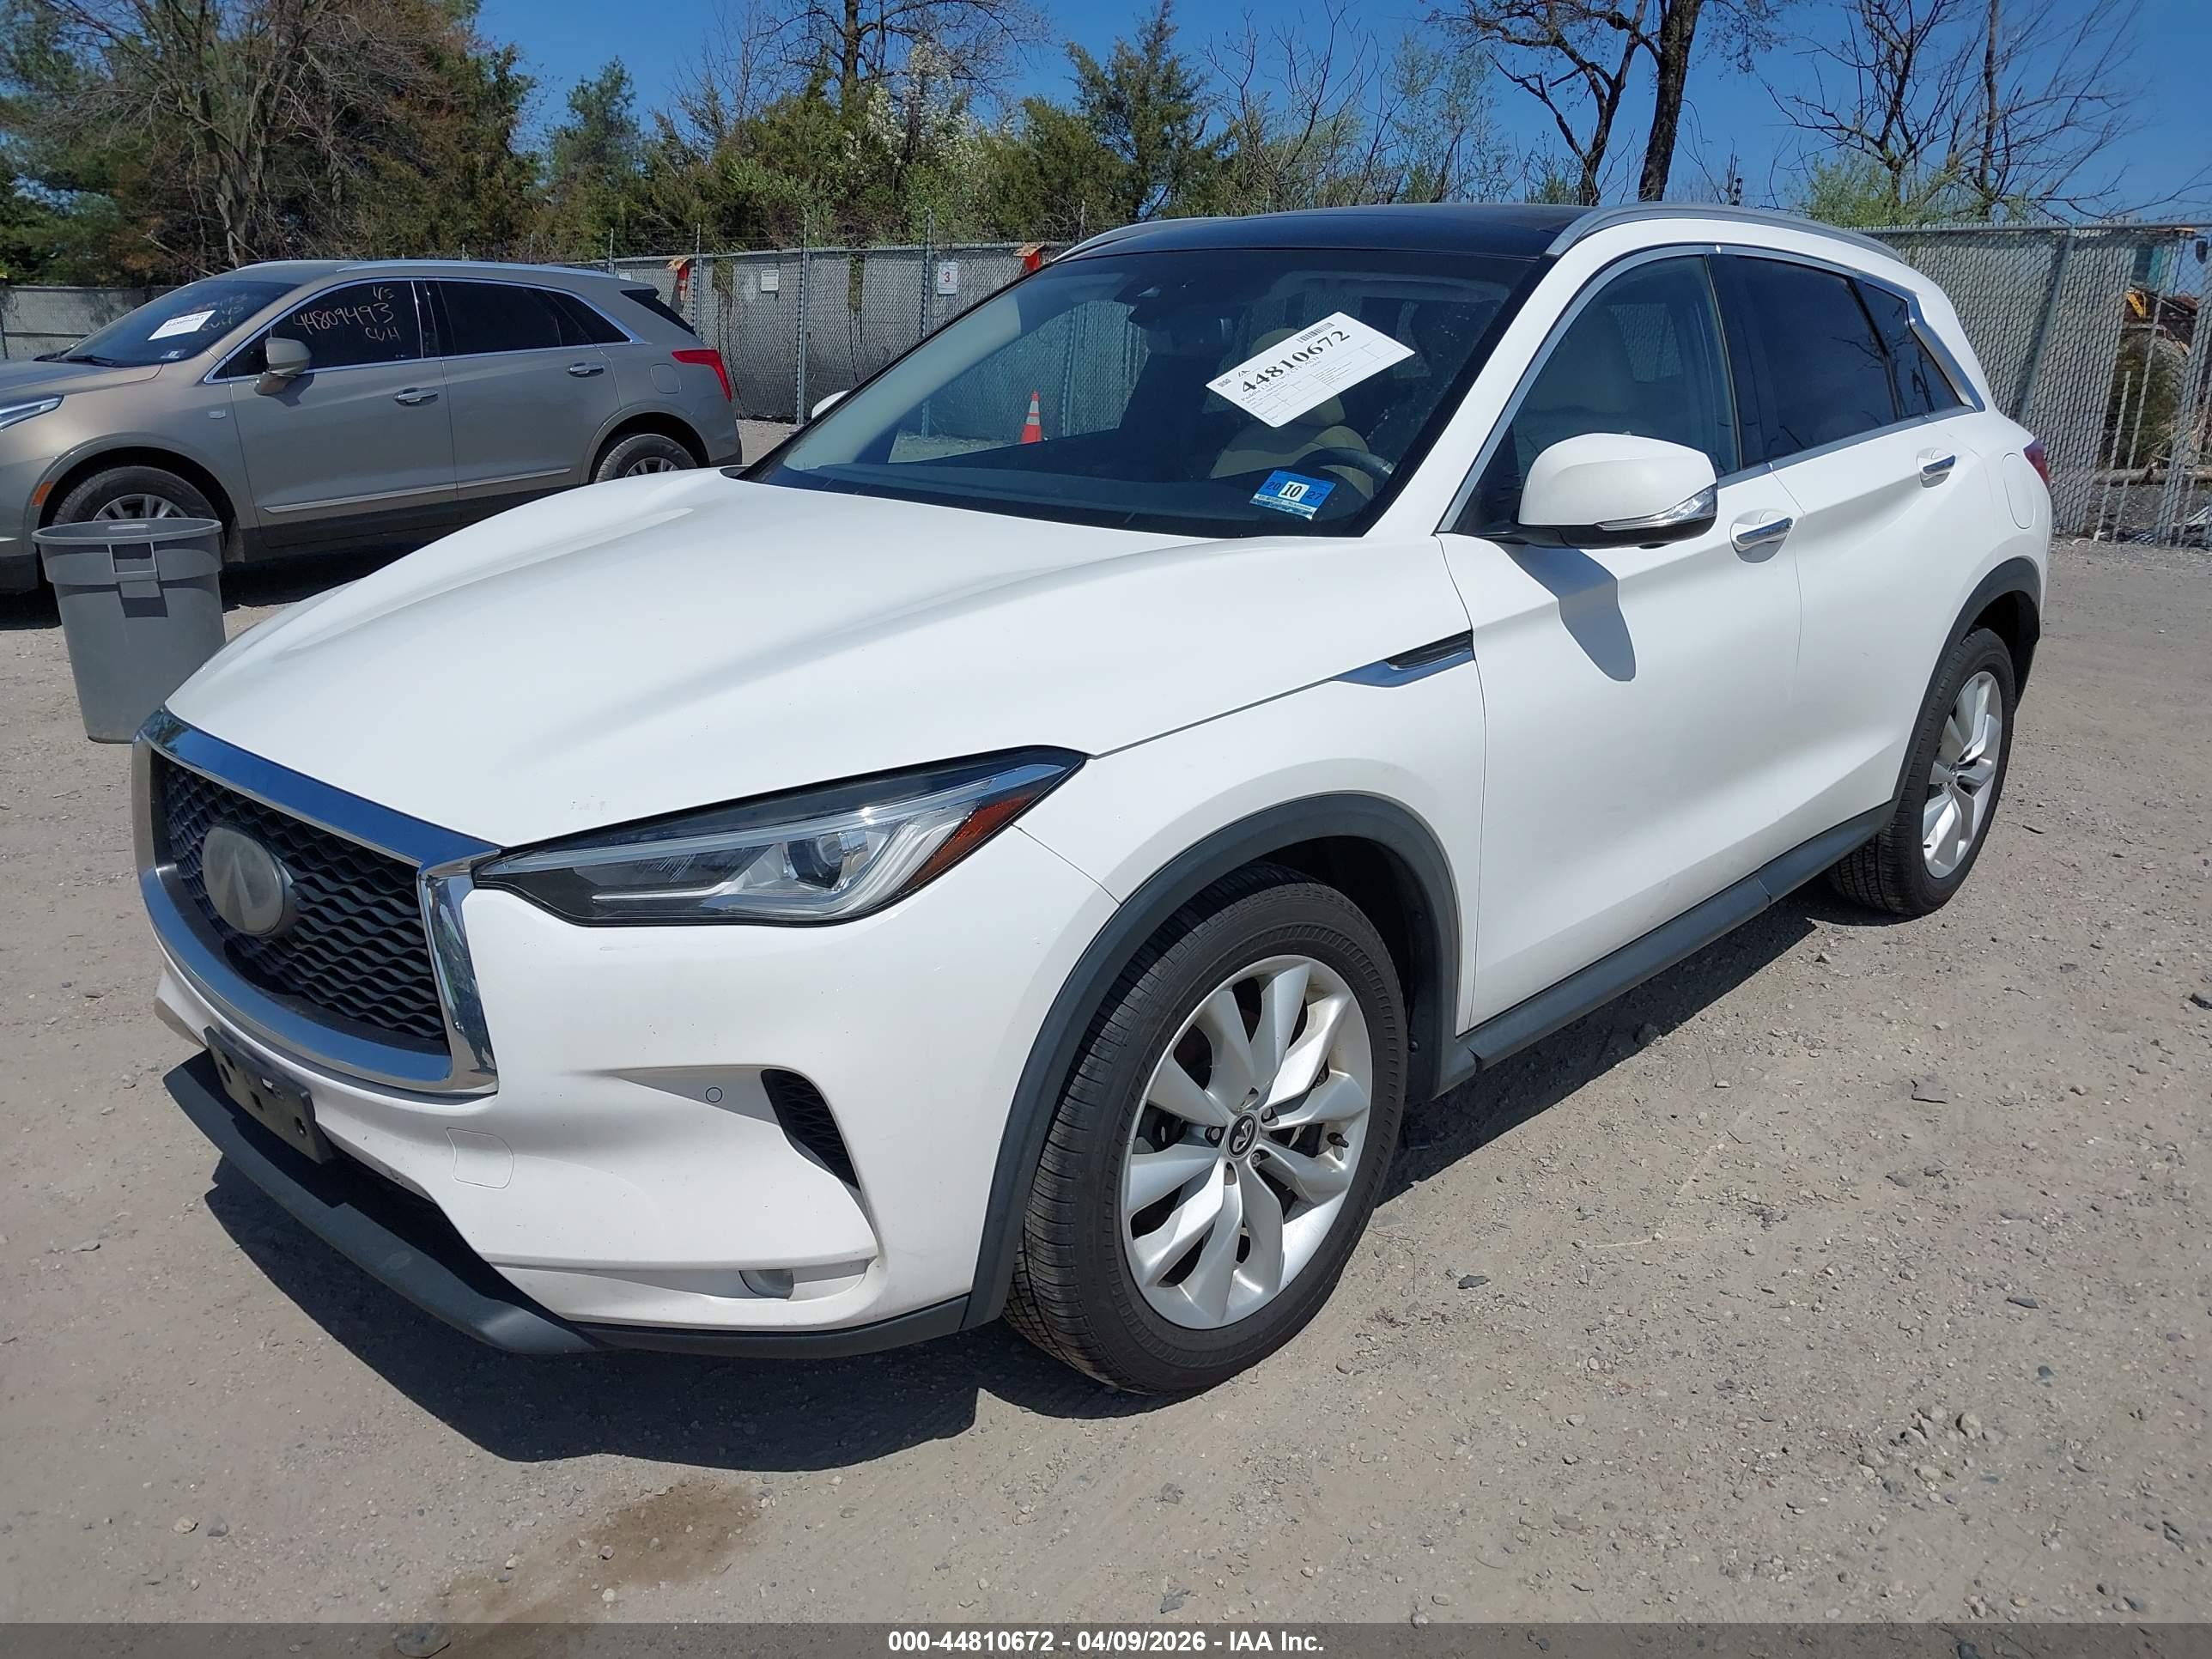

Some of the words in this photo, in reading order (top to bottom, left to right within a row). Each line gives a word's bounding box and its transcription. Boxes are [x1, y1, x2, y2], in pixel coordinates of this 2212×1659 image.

[292, 302, 394, 336] 44809493
[1242, 330, 1351, 394] 44810672
[1267, 481, 1282, 491] 20
[1280, 483, 1303, 498] 10
[1306, 490, 1323, 501] 27
